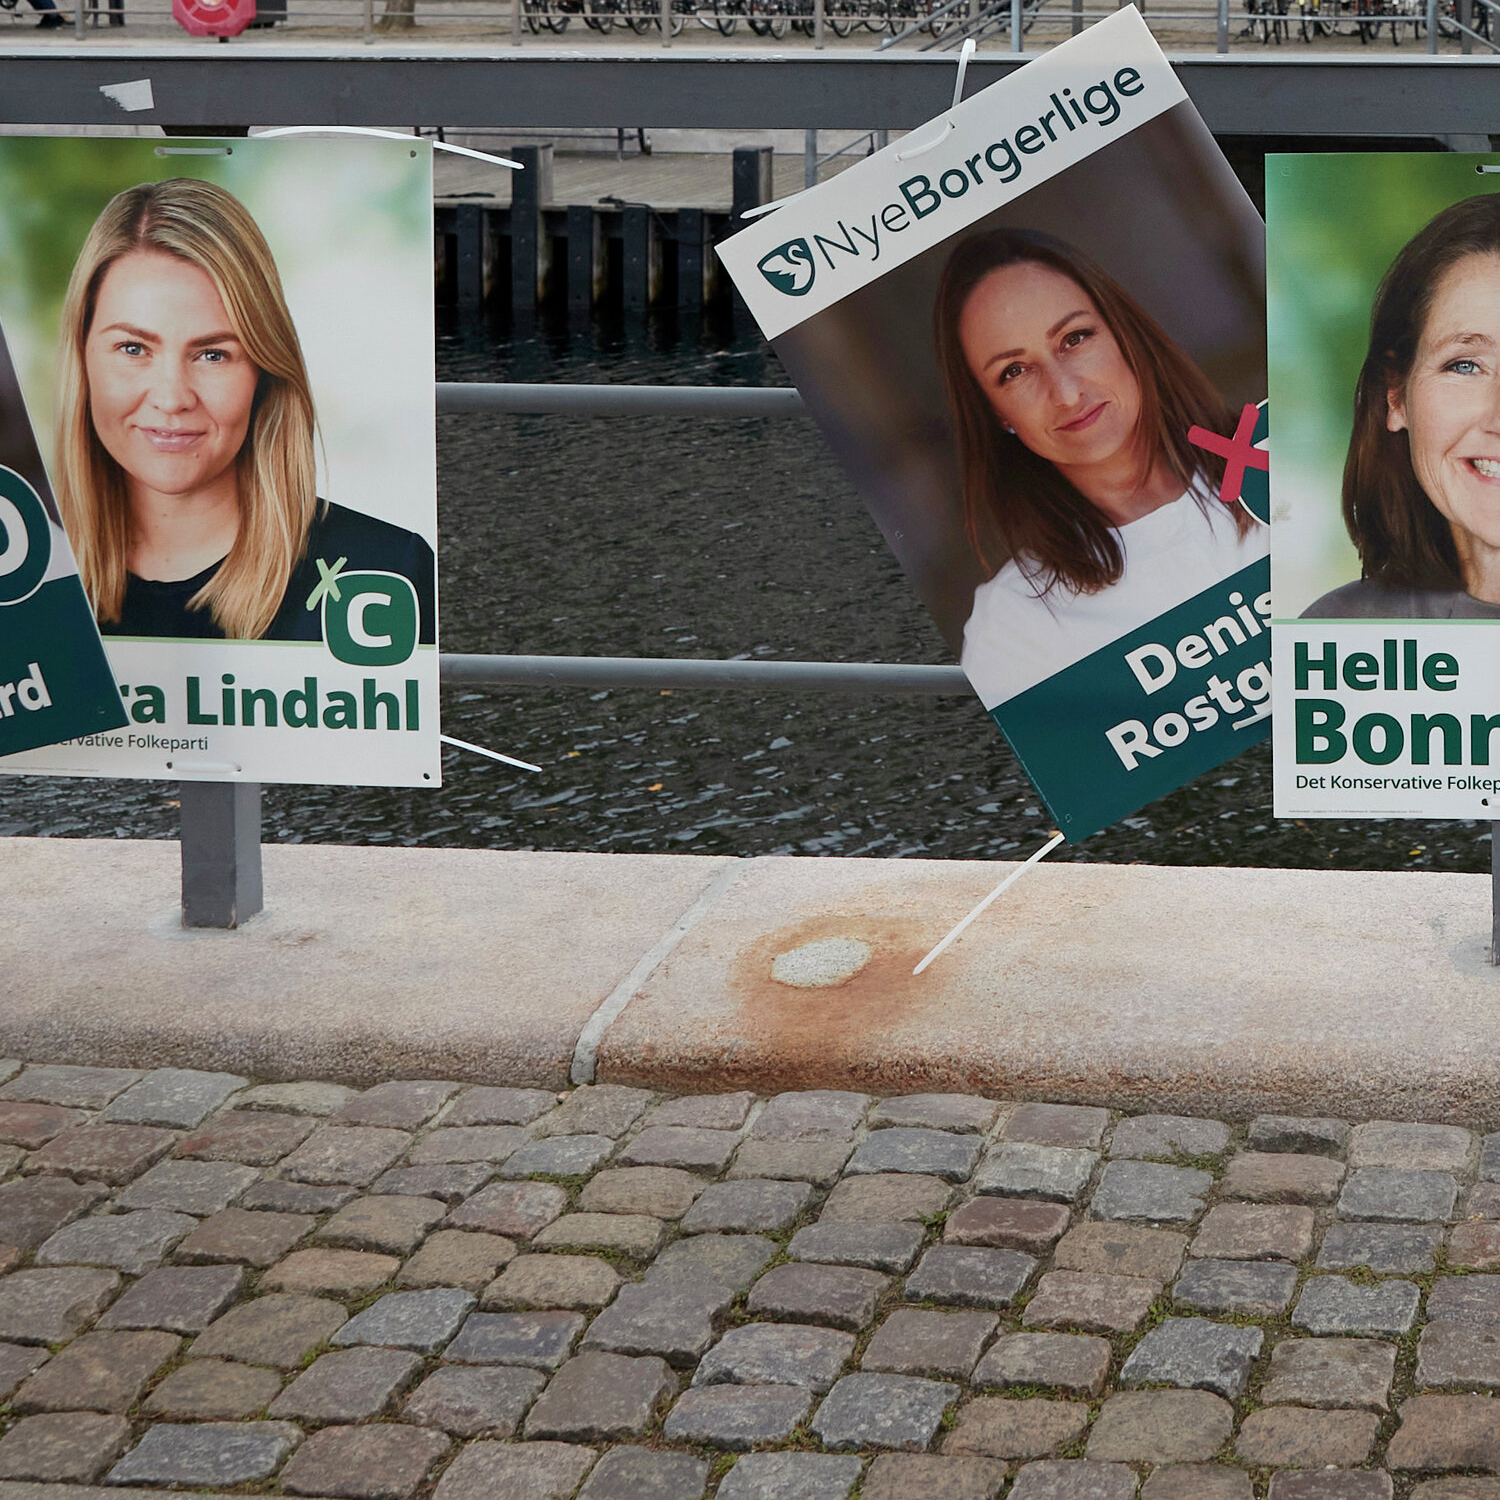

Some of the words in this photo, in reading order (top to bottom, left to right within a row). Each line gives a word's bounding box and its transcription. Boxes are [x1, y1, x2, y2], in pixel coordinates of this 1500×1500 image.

[813, 67, 1145, 271] NyeBorgerlige
[346, 592, 393, 648] C
[0, 662, 53, 720] rd
[1294, 639, 1460, 692] Helle
[186, 673, 420, 731] Lindahl
[128, 735, 209, 752] Folkeparti
[1296, 775, 1326, 789] Det
[1331, 776, 1443, 790] Konservative
